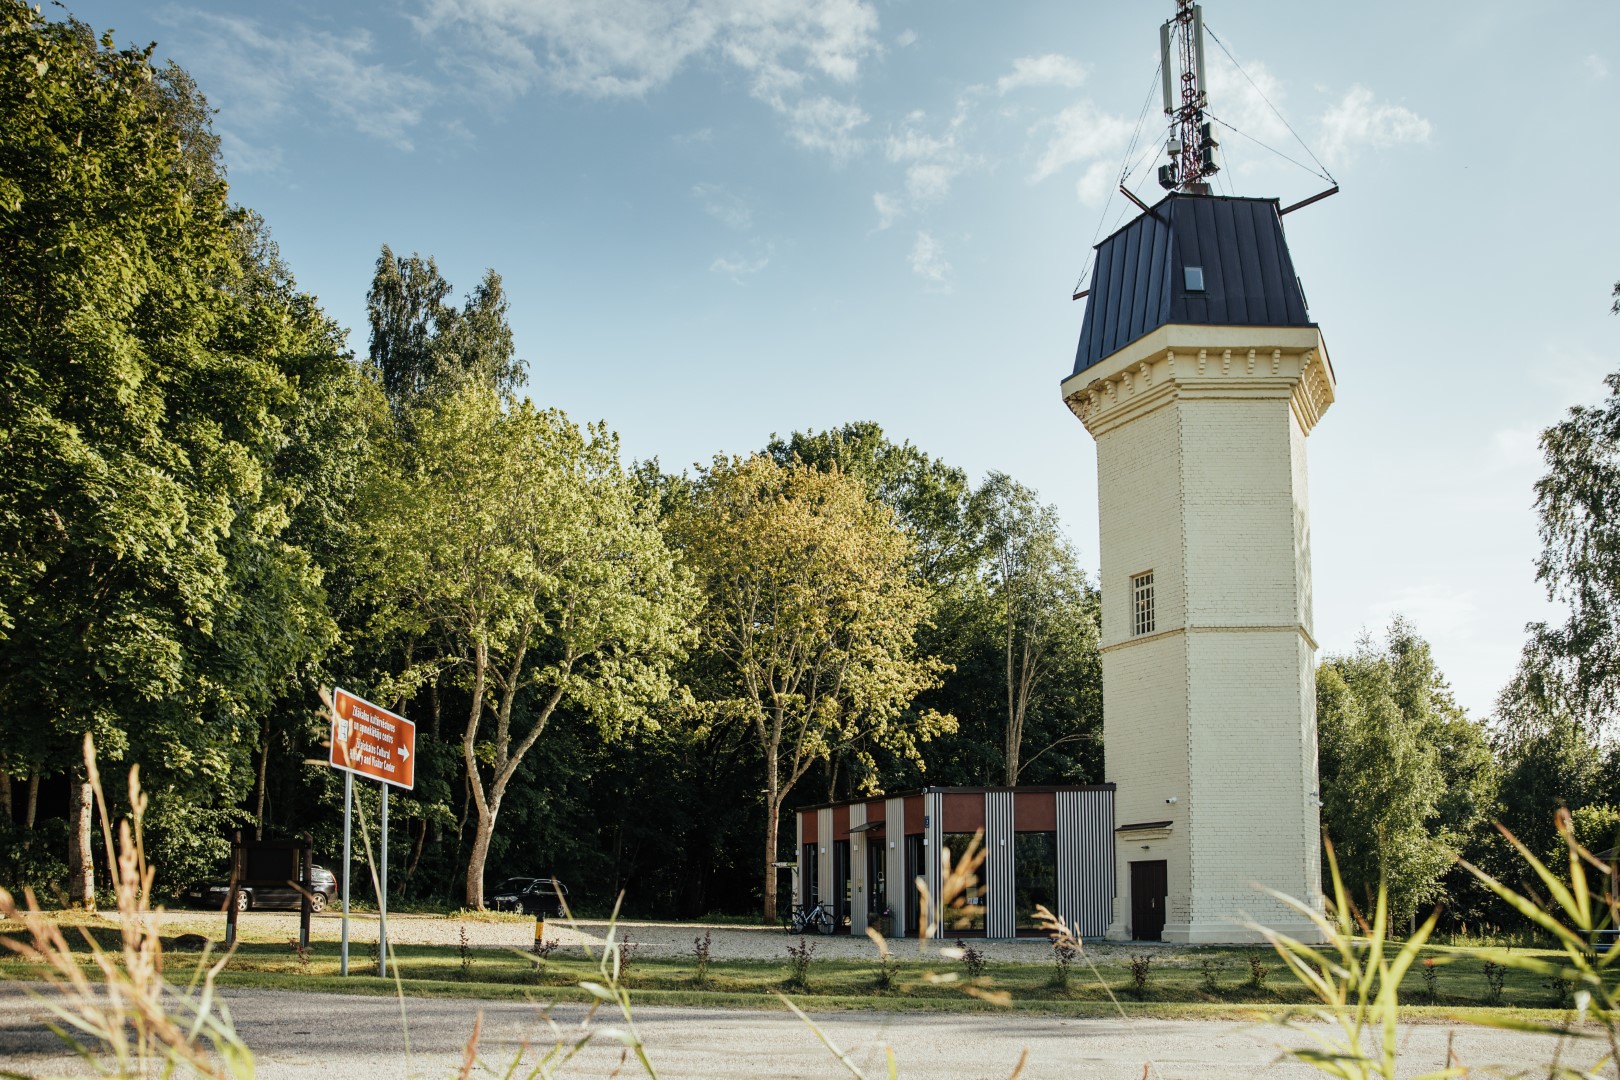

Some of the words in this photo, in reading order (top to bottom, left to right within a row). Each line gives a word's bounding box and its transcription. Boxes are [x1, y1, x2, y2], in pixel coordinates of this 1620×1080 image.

[376, 746, 390, 760] Cultural
[363, 754, 371, 765] and
[372, 756, 383, 769] Visitor
[384, 760, 396, 773] Center
